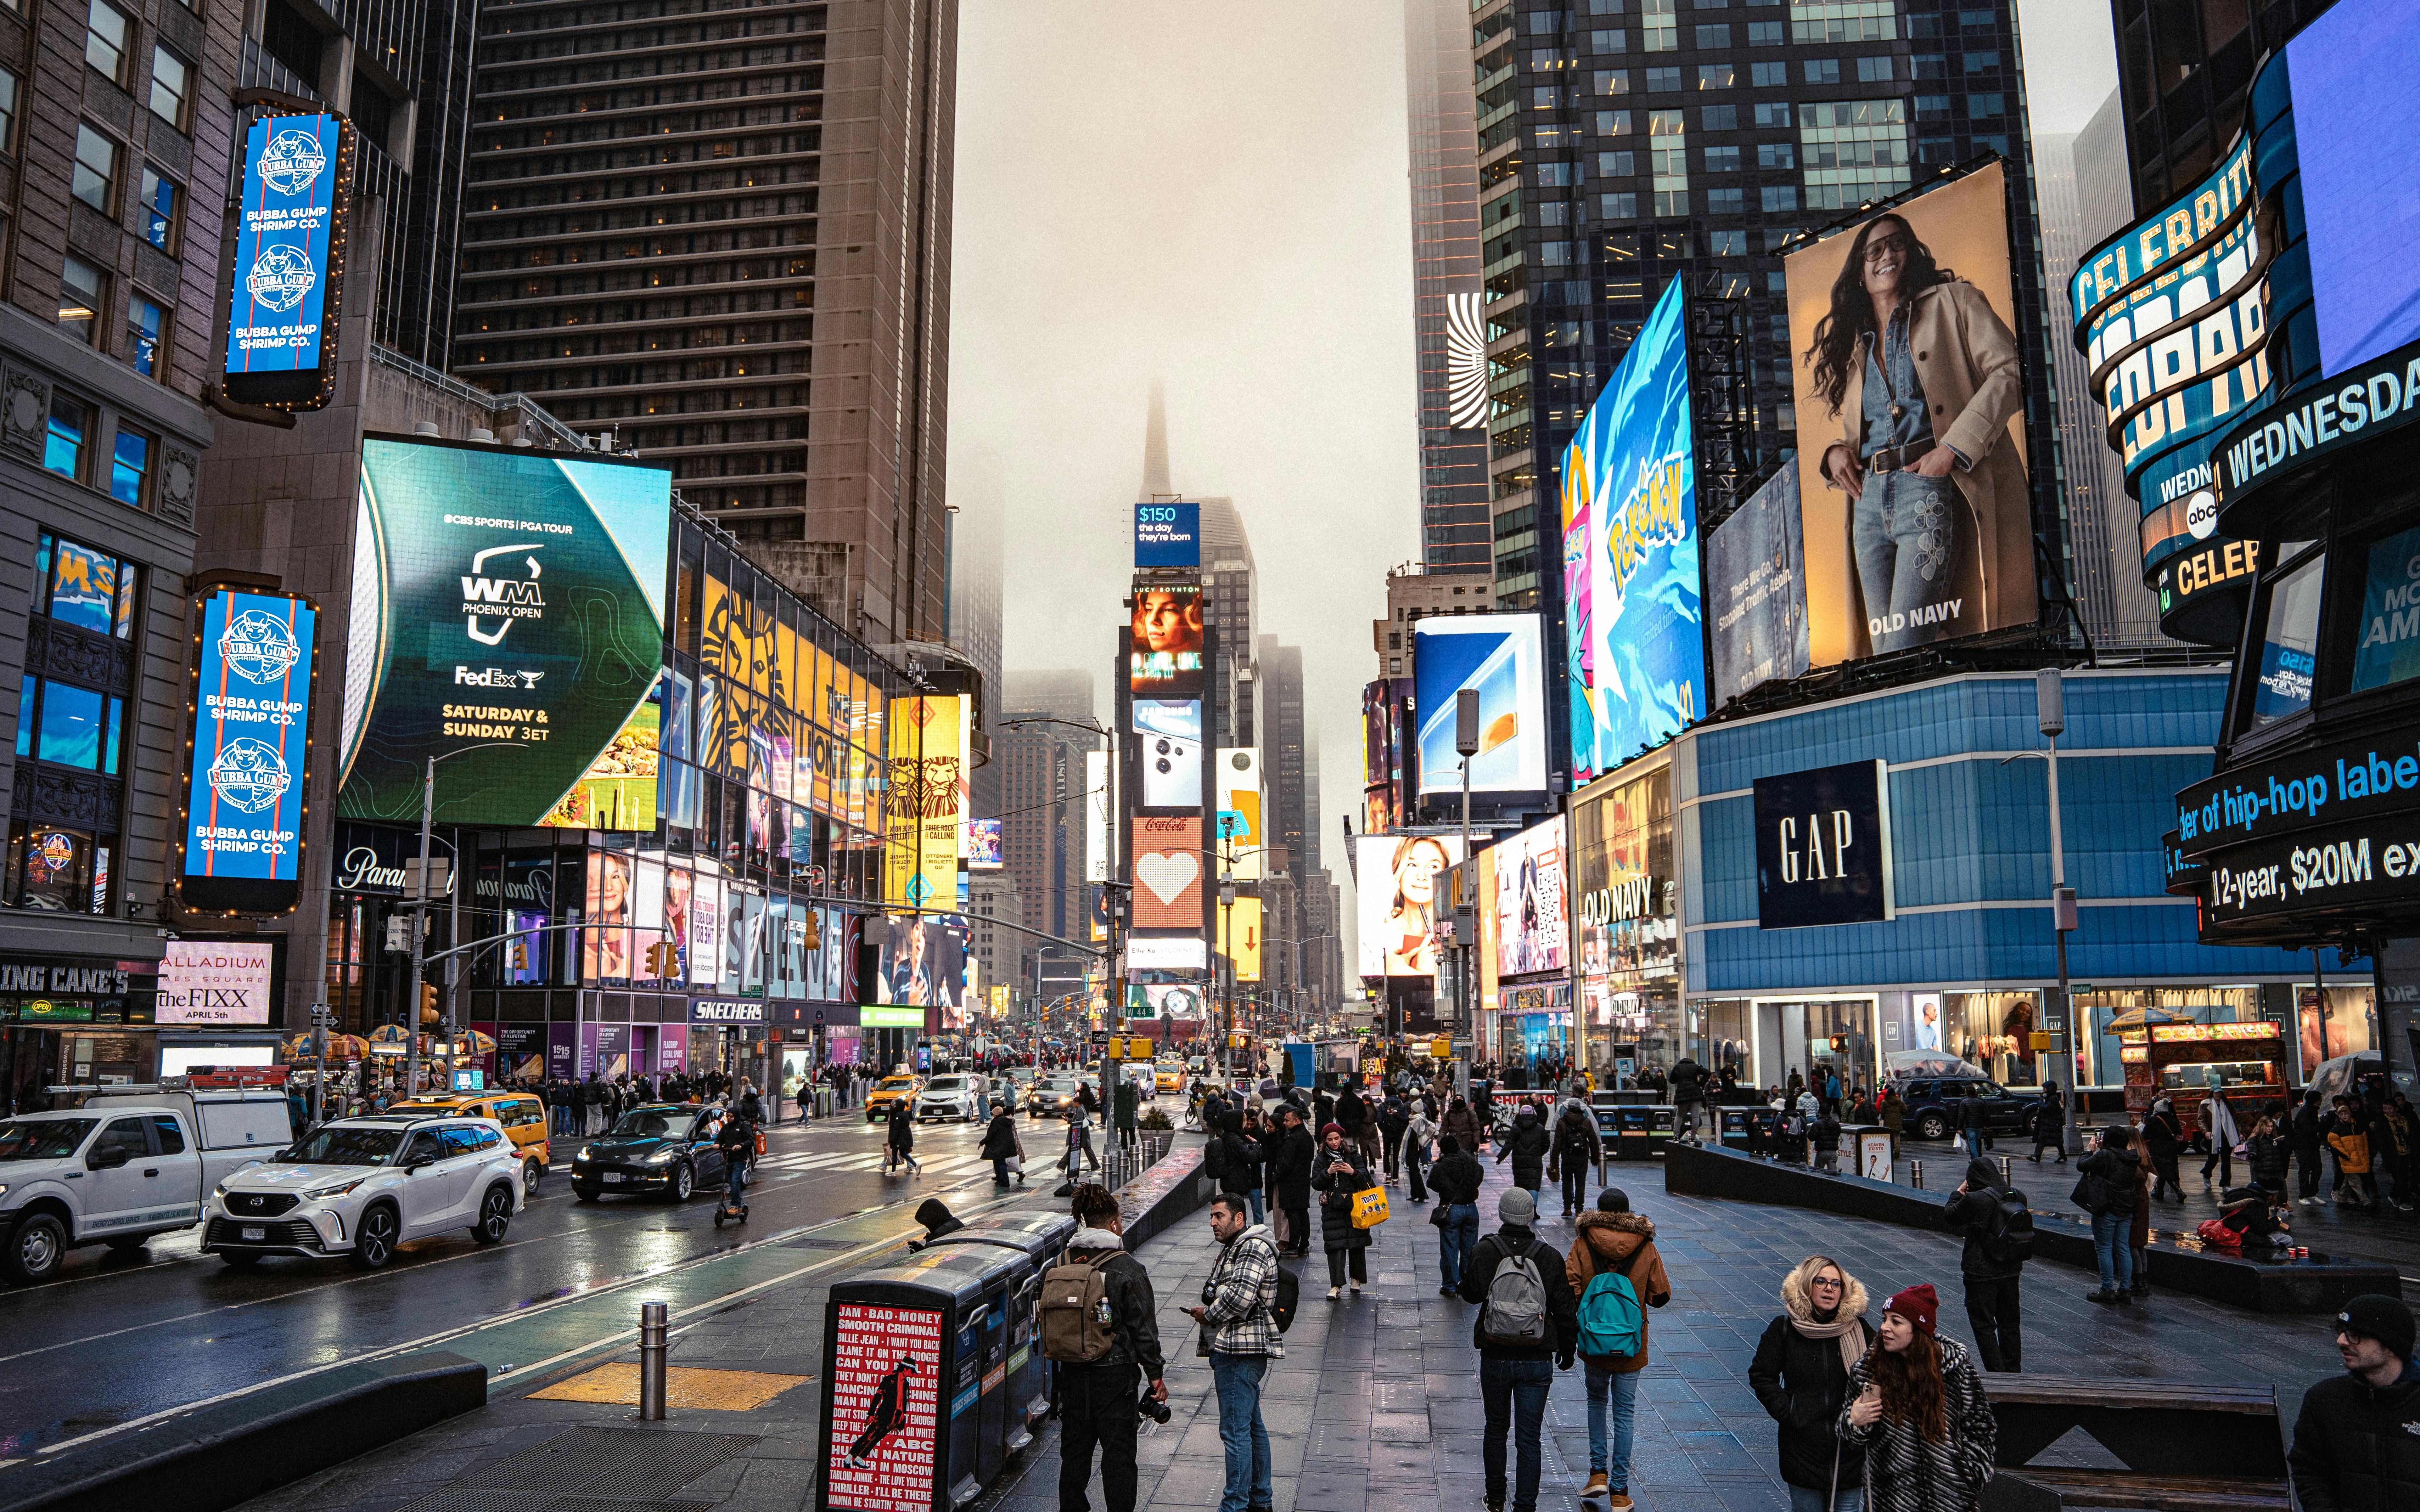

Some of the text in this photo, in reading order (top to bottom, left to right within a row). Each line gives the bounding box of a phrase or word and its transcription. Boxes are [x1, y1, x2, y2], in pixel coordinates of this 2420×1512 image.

[261, 158, 324, 173] BUBBA GUMP
[247, 207, 327, 221] BUBBA GUMP
[250, 219, 320, 231] SHRIMP CO.
[236, 325, 316, 338] BUBBA GUMP
[239, 337, 310, 349] SHRIMP CO.
[1139, 506, 1175, 523] $150
[2189, 503, 2216, 525] abc
[453, 515, 572, 534] CBS SPORTS PGA TOUR
[1155, 524, 1172, 533] day
[1139, 533, 1168, 542] they're
[1731, 561, 1772, 600] There We Go,
[1719, 569, 1792, 632] Stopping Traffic Again.
[463, 603, 541, 618] PHOENIX OPEN
[1869, 599, 1961, 636] OLD NAVY
[223, 642, 297, 660] BUBBA GUMP
[455, 666, 517, 688] FedEx
[1741, 659, 1772, 690] OLD NAVY
[206, 695, 302, 713] BUBBA GUMP
[826, 684, 849, 723] THE
[1142, 707, 1192, 716] SAMSUNG
[211, 708, 295, 726] SHRIMP CO.
[443, 704, 548, 723] SATURDAY &
[443, 723, 515, 738] SUNDAY
[814, 798, 829, 809] ENTRANCE
[833, 803, 837, 813] ON
[2202, 793, 2219, 832] of
[2224, 775, 2327, 830] hip-hop
[196, 826, 294, 842] BUBBA GUMP
[201, 839, 286, 854] SHRIMP CO.
[1781, 810, 1852, 882] GAP
[2291, 838, 2372, 895] $20M
[1585, 888, 1610, 927] OLD
[1612, 876, 1652, 921] NAVY
[160, 957, 265, 968] ALLADIUM
[0, 965, 128, 994] ING CANE'S
[33, 1001, 50, 1011] OPEN
[159, 989, 249, 1007] the FIXX
[696, 1002, 762, 1020] SKECHERS
[1612, 999, 1639, 1015] OLD NAVY
[92, 1214, 140, 1228] ENERGY CONTROL SERVICE
[839, 1307, 941, 1324] JAM BAD MONEY
[838, 1319, 940, 1336] SMOOTH CRIMINAL
[836, 1358, 938, 1375] CAN YOU IT
[836, 1371, 937, 1388] THEY DON'T US
[951, 1387, 978, 1415] TIMES SQUARE
[893, 1439, 934, 1451] ABC
[883, 1450, 933, 1463] NATURE
[880, 1462, 933, 1476] IN MOSCOW
[830, 1470, 932, 1489] TABLOID JUNKIE THE LOVE YOU SAVE
[830, 1482, 932, 1501] THRILLER I'LL BE THERE
[829, 1495, 852, 1506] WANNA
[854, 1497, 861, 1506] BE
[864, 1498, 893, 1510] STARTIN'
